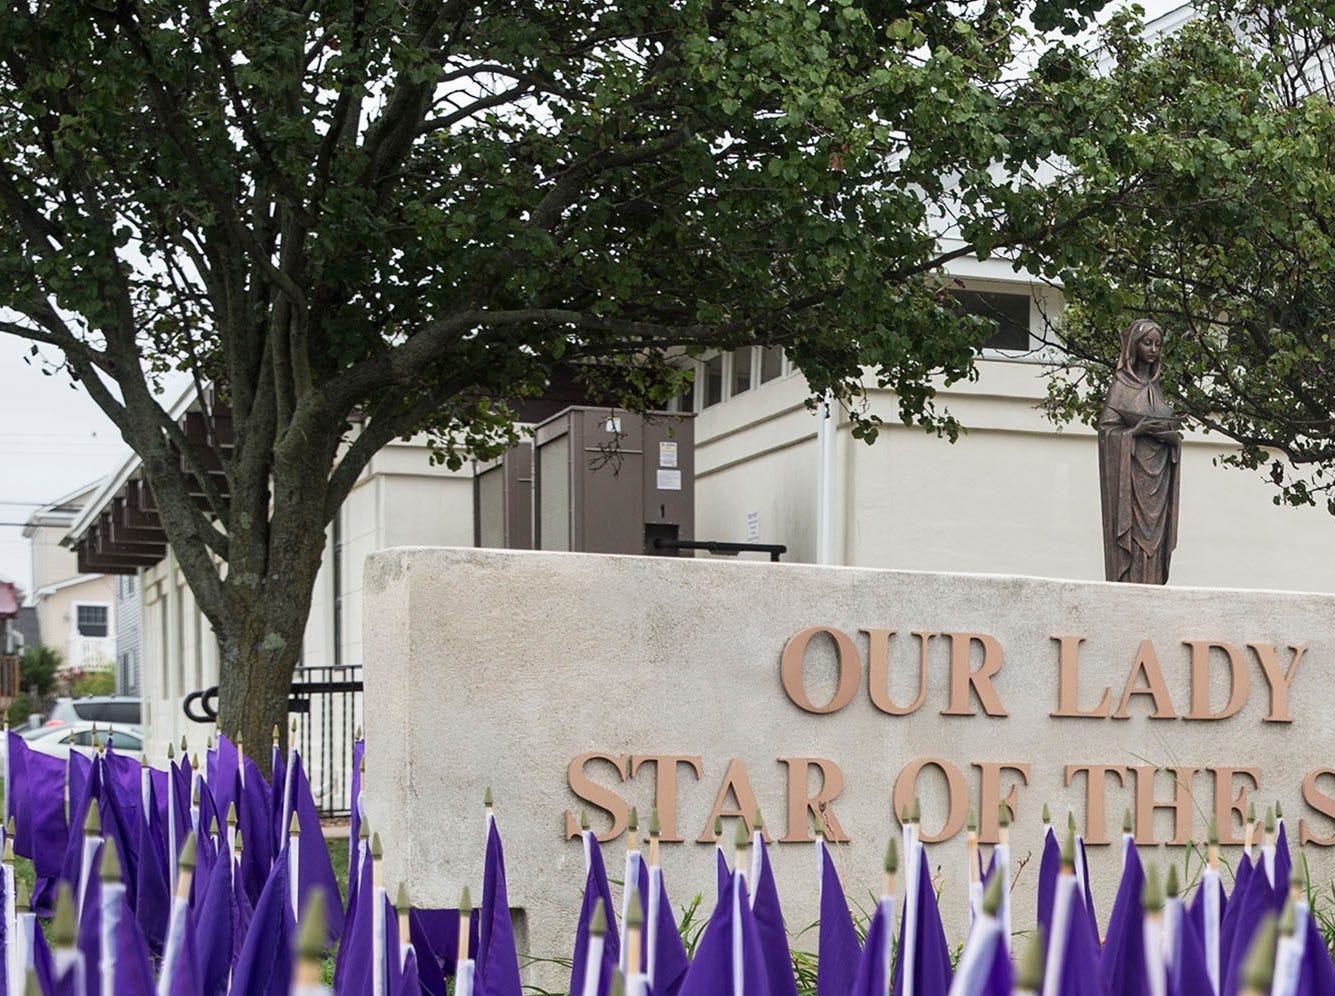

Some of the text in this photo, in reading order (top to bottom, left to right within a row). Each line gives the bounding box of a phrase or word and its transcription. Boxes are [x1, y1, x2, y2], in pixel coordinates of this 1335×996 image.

[781, 626, 1309, 723] OUR LADY
[564, 751, 851, 844] STAR
[892, 757, 1031, 845] OF
[1064, 764, 1262, 846] THE
